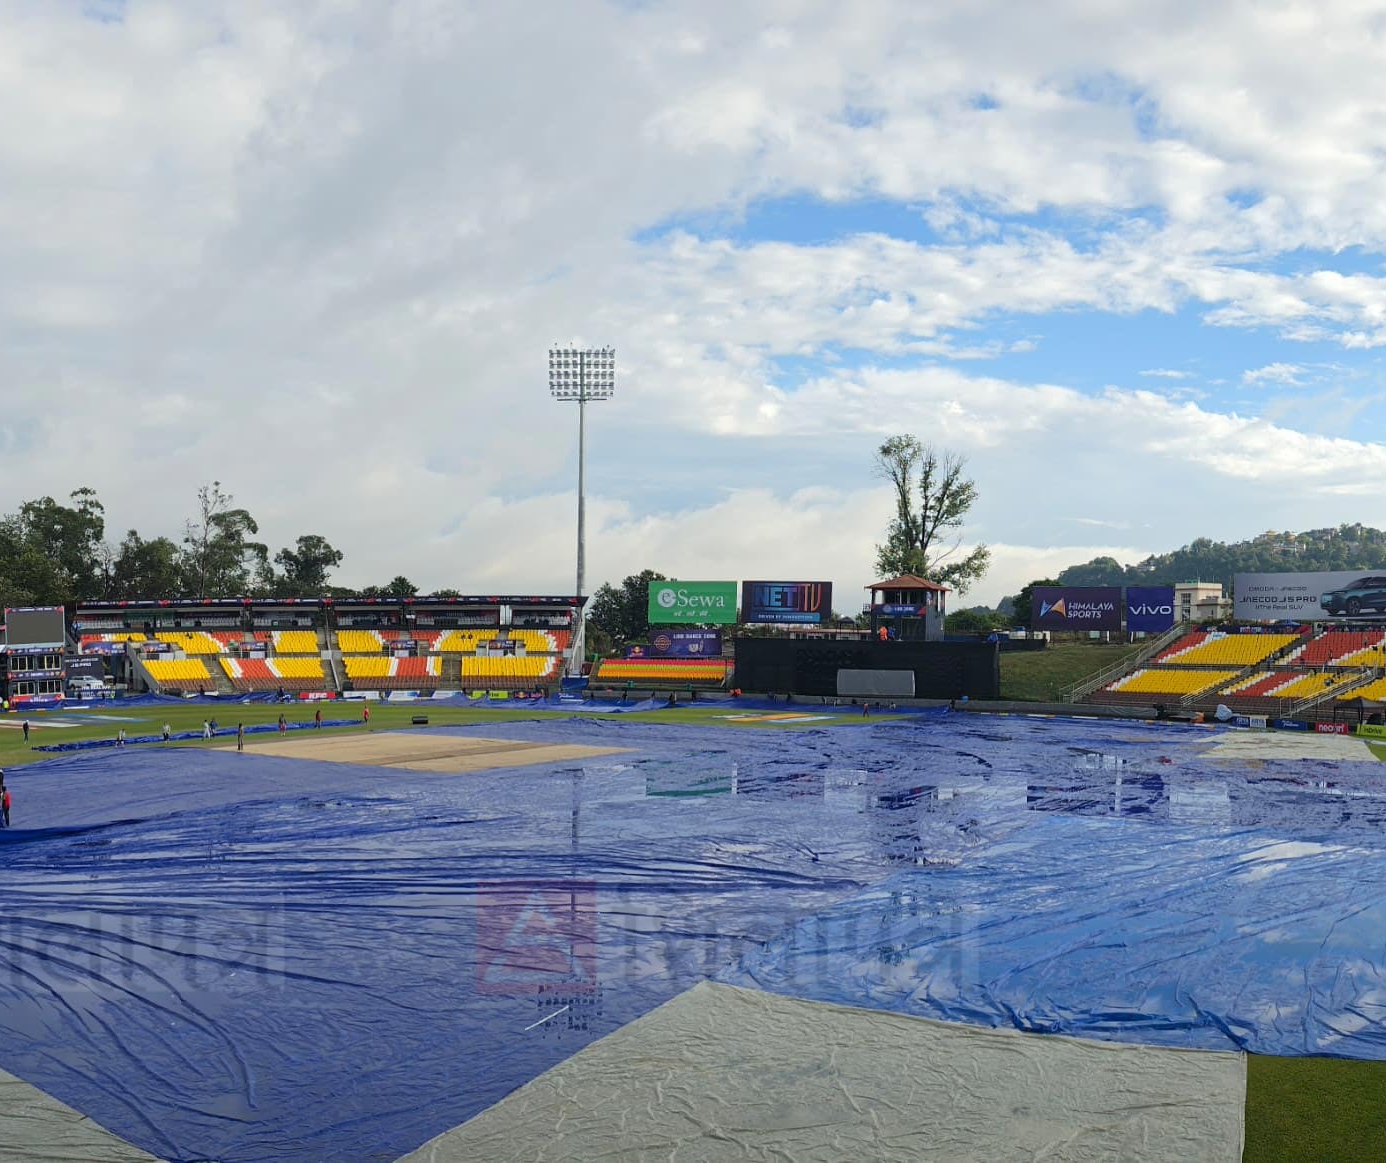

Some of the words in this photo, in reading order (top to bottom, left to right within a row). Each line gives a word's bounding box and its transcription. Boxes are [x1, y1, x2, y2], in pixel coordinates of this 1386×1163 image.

[657, 588, 725, 608] eSewa
[1239, 595, 1277, 603] JAECOO
[1068, 602, 1114, 610] HIMALAYA
[1129, 603, 1172, 615] vivo
[1067, 610, 1102, 619] SPORTS
